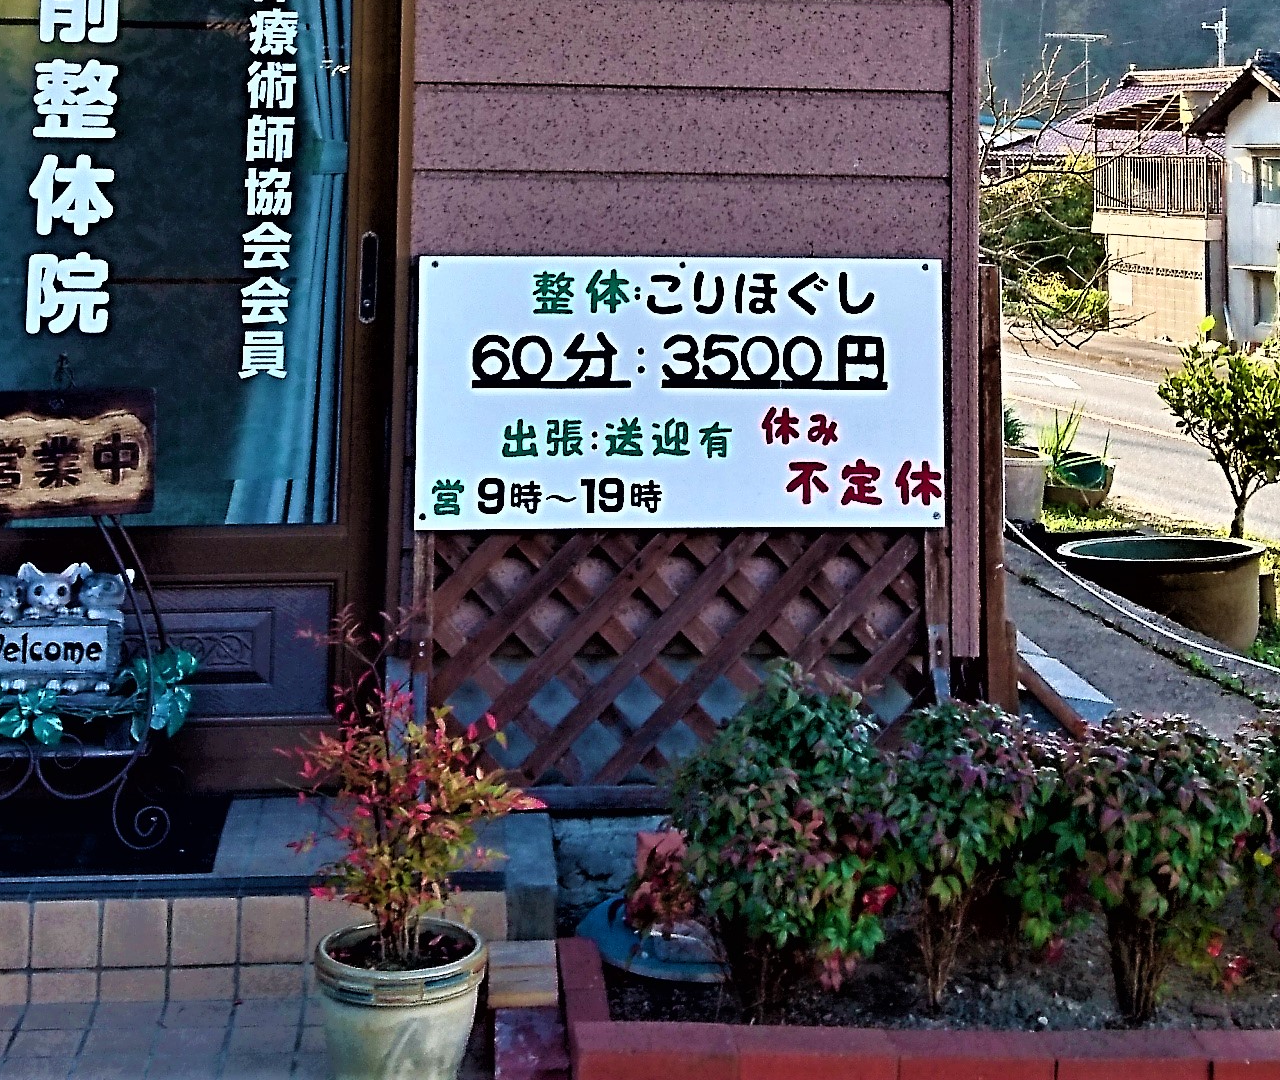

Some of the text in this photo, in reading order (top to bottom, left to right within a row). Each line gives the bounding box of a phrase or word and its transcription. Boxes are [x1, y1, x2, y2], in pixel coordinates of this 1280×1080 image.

[761, 406, 839, 447] 休み
[785, 459, 944, 508] 不定休
